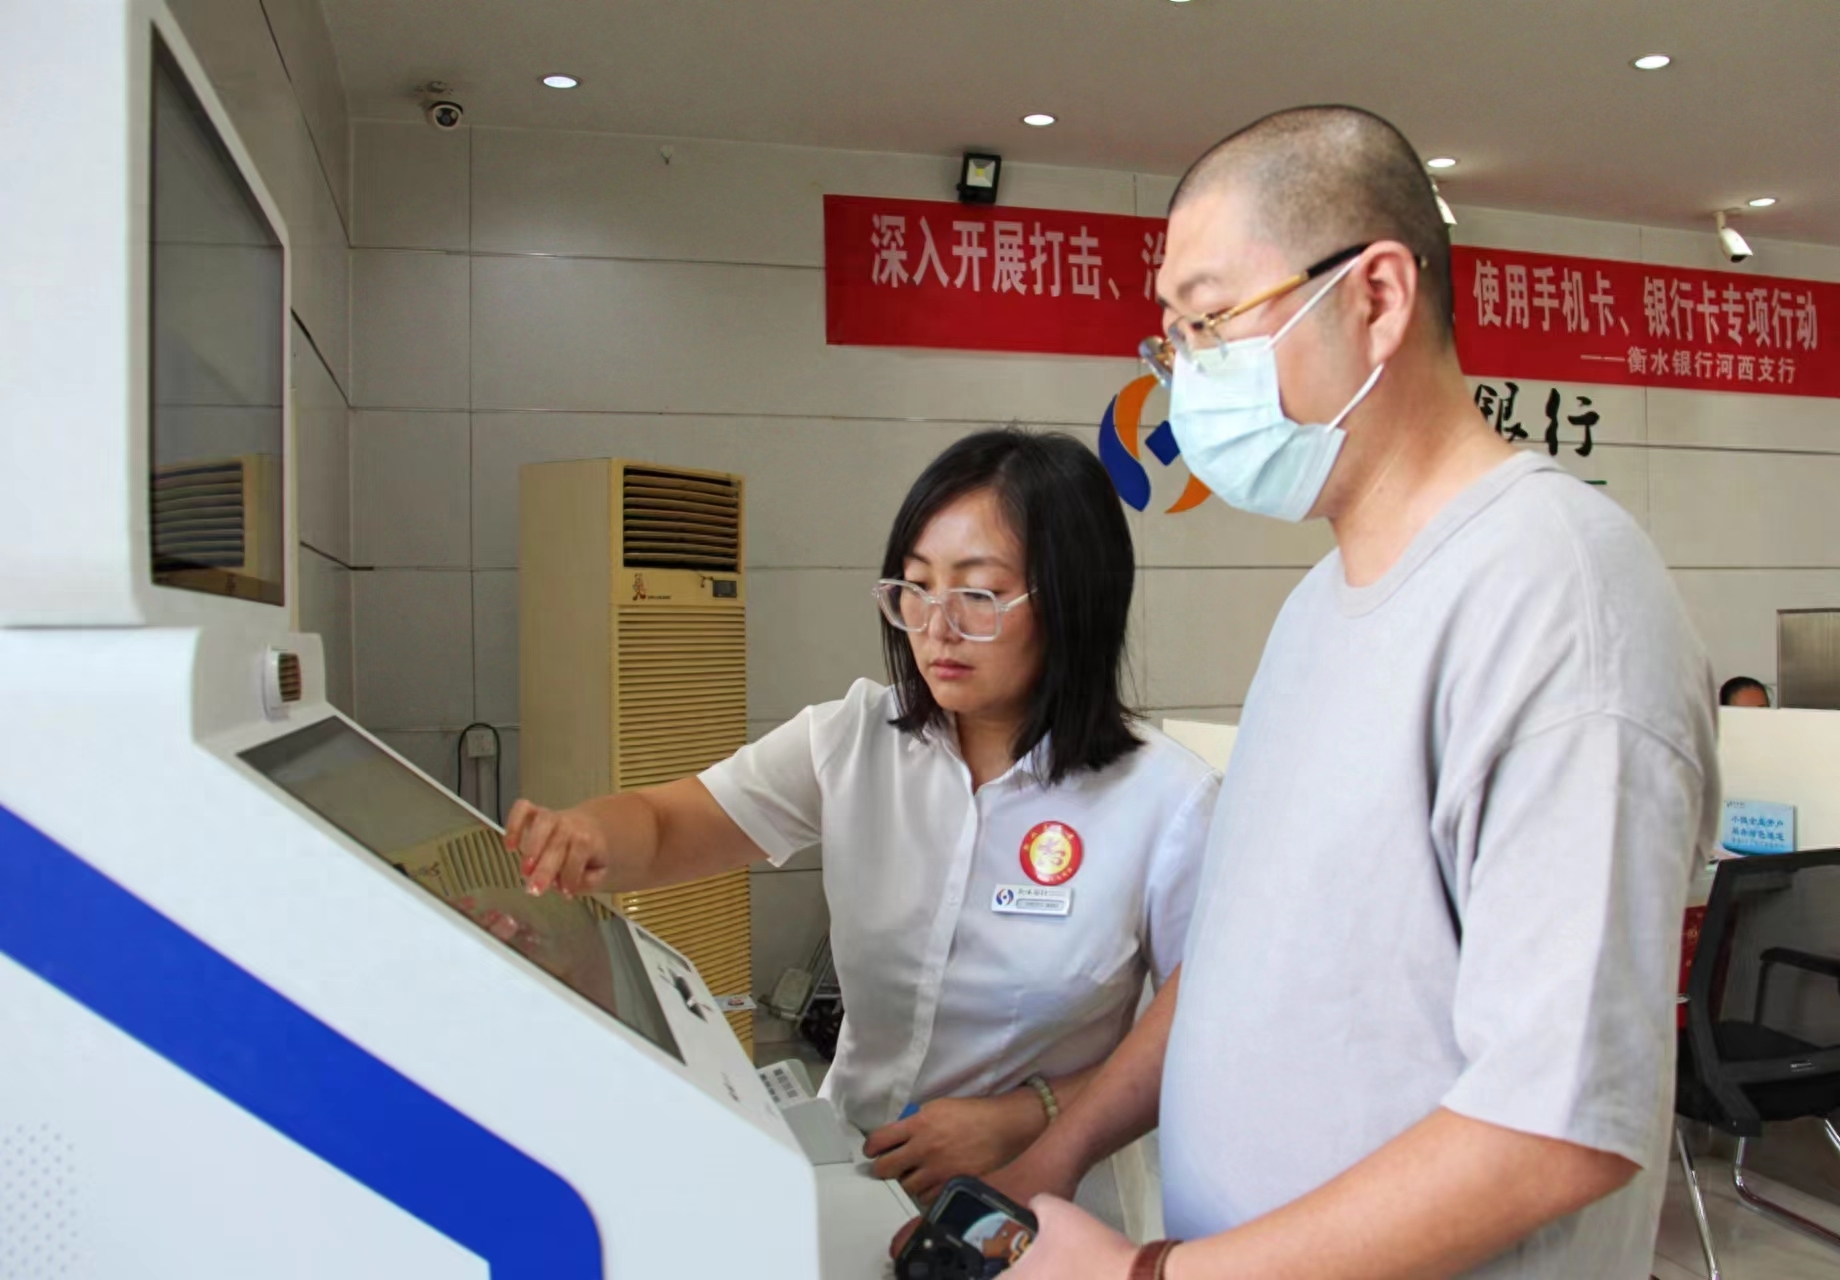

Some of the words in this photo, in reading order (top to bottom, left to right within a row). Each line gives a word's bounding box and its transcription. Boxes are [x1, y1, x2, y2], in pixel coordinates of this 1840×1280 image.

[1473, 258, 1819, 351] 使用手机卡、银行卡专项行动
